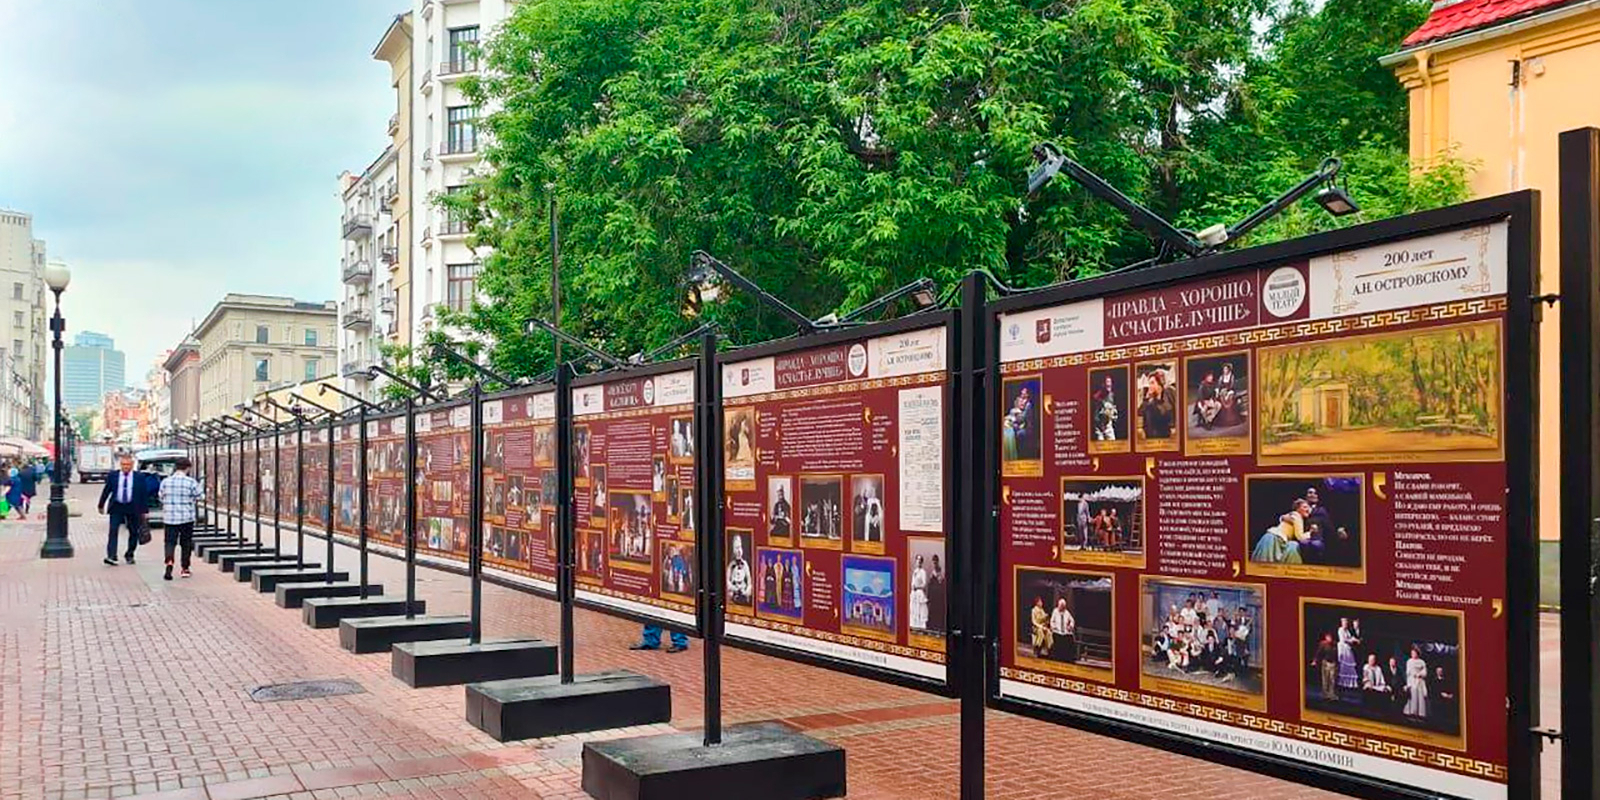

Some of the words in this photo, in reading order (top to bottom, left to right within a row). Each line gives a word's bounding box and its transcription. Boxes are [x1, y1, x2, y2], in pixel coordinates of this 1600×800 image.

[1384, 252, 1410, 267] 200
[1411, 250, 1434, 263] лет
[1352, 281, 1373, 296] А.Н.
[1374, 266, 1471, 293] ОСТРОВСКОМУ
[1106, 296, 1166, 320] «ПРАВДА
[1179, 280, 1254, 310] ХОРОШО,
[1269, 287, 1299, 300] МАЛЫЙ
[1272, 299, 1298, 309] ТЕАТР
[1108, 322, 1118, 339] А
[1119, 312, 1184, 337] СЧАСТЬЕ
[1185, 302, 1250, 331] ЛУЧШЕ»
[1295, 746, 1354, 769] СОЛОМИН
